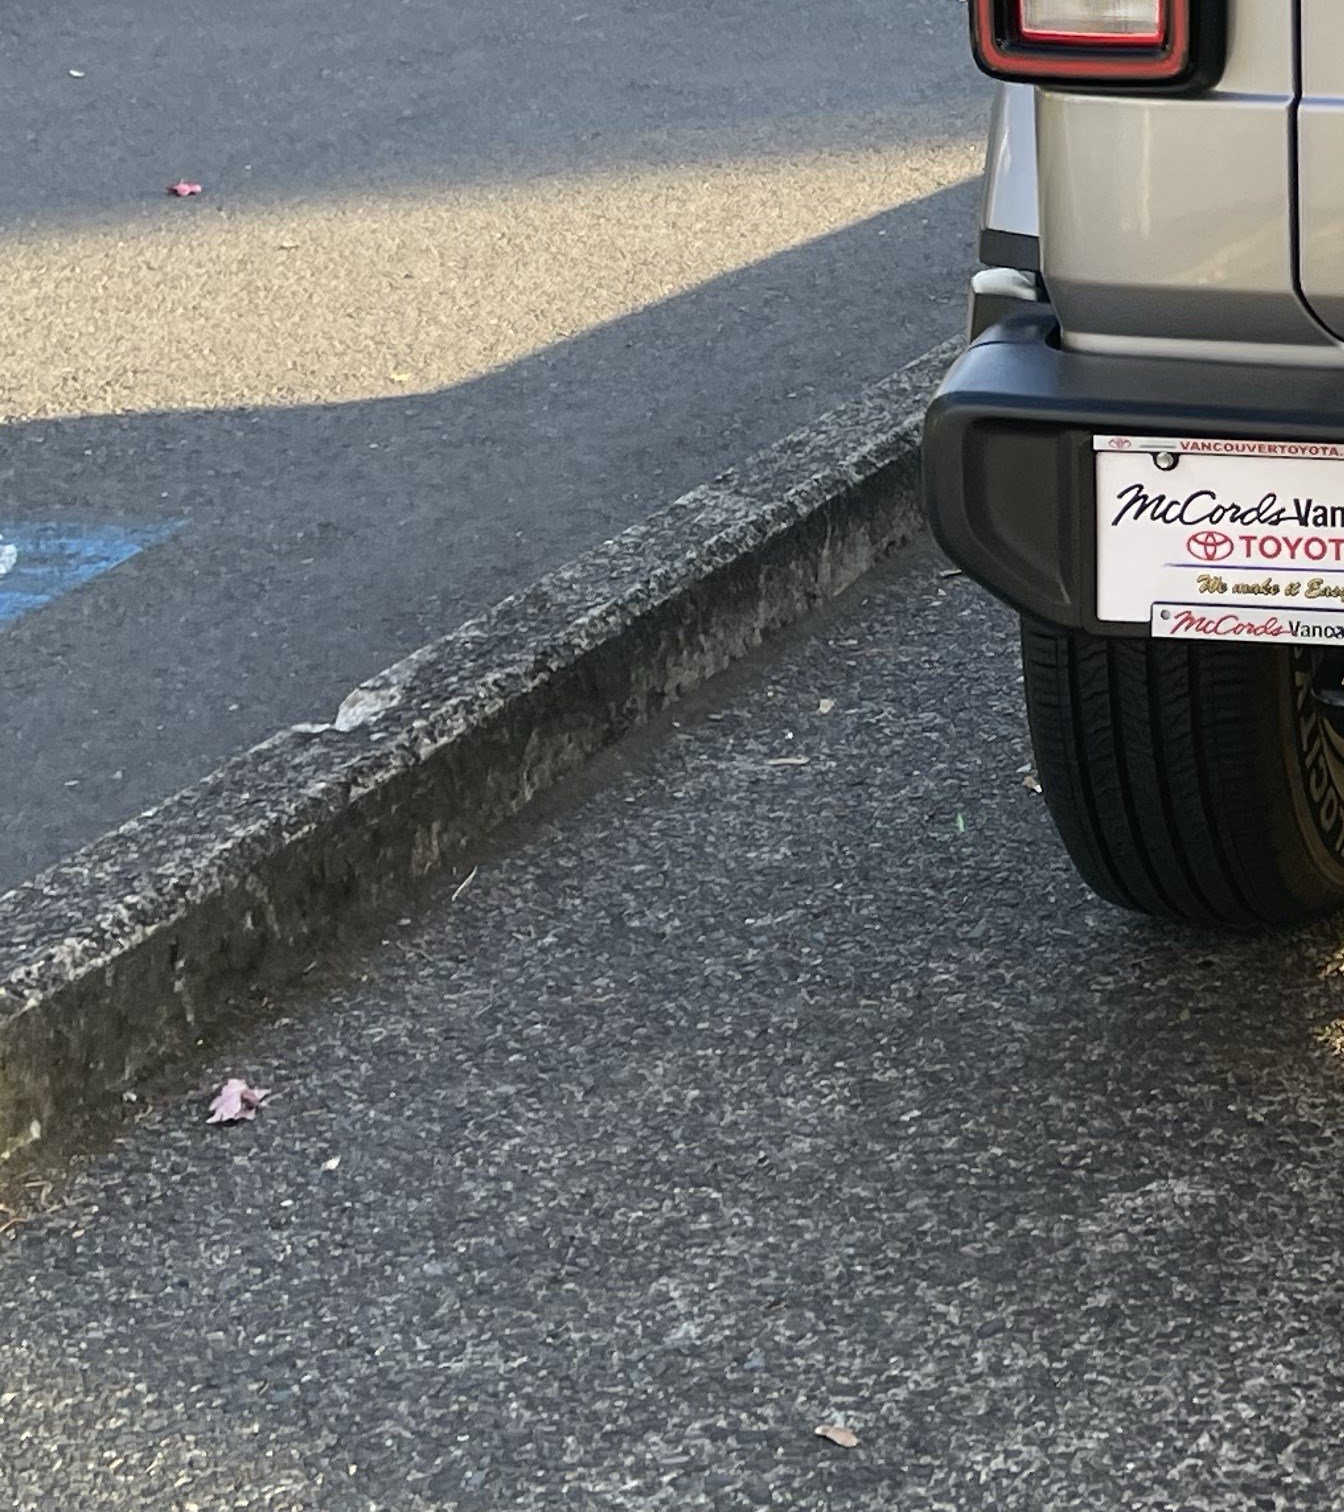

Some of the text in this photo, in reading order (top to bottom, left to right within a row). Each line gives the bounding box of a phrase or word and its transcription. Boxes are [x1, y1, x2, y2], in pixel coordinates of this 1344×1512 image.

[1197, 574, 1228, 595] We
[1232, 577, 1280, 597] make
[1285, 580, 1301, 596] it
